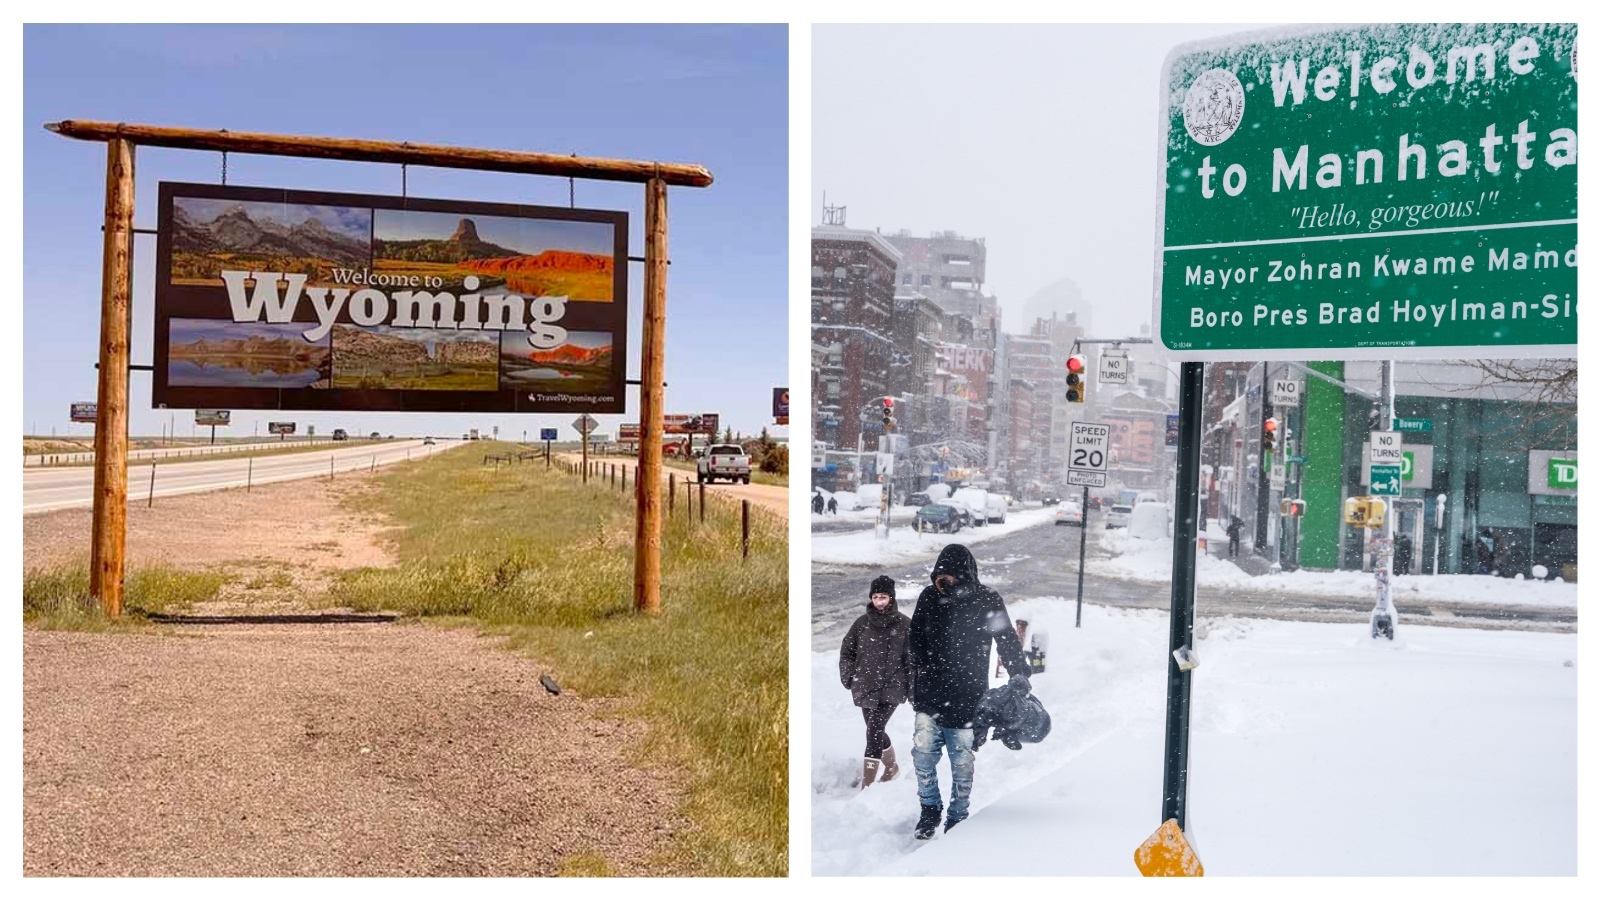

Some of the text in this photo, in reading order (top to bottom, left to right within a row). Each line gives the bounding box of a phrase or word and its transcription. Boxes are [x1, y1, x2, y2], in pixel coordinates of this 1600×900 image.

[1270, 36, 1541, 107] Welcome
[1198, 119, 1577, 199] to Manhatta
[1291, 191, 1500, 230] "Hello, gorgeous!"
[1185, 244, 1577, 289] Mayor Zohran Kwame Mamd
[331, 268, 443, 288] Welcome to
[220, 270, 569, 350] Wyoming
[1190, 293, 1577, 328] Boro Pres Brad Hoylman-Si
[1107, 360, 1120, 369] NO
[1101, 371, 1126, 380] TURNS
[1276, 382, 1296, 393] NO
[536, 393, 615, 404] TravelWyoming.com
[1273, 394, 1298, 404] TURNS
[1399, 419, 1424, 430] Bowery
[1074, 426, 1107, 436] SPEED
[1076, 436, 1102, 446] LIMIT
[1379, 436, 1393, 446] NO
[1073, 449, 1103, 467] 20
[1371, 448, 1400, 458] TURNS
[1076, 471, 1098, 479] PHOTO
[1553, 464, 1578, 482] TD
[1070, 477, 1103, 485] ENFORCED
